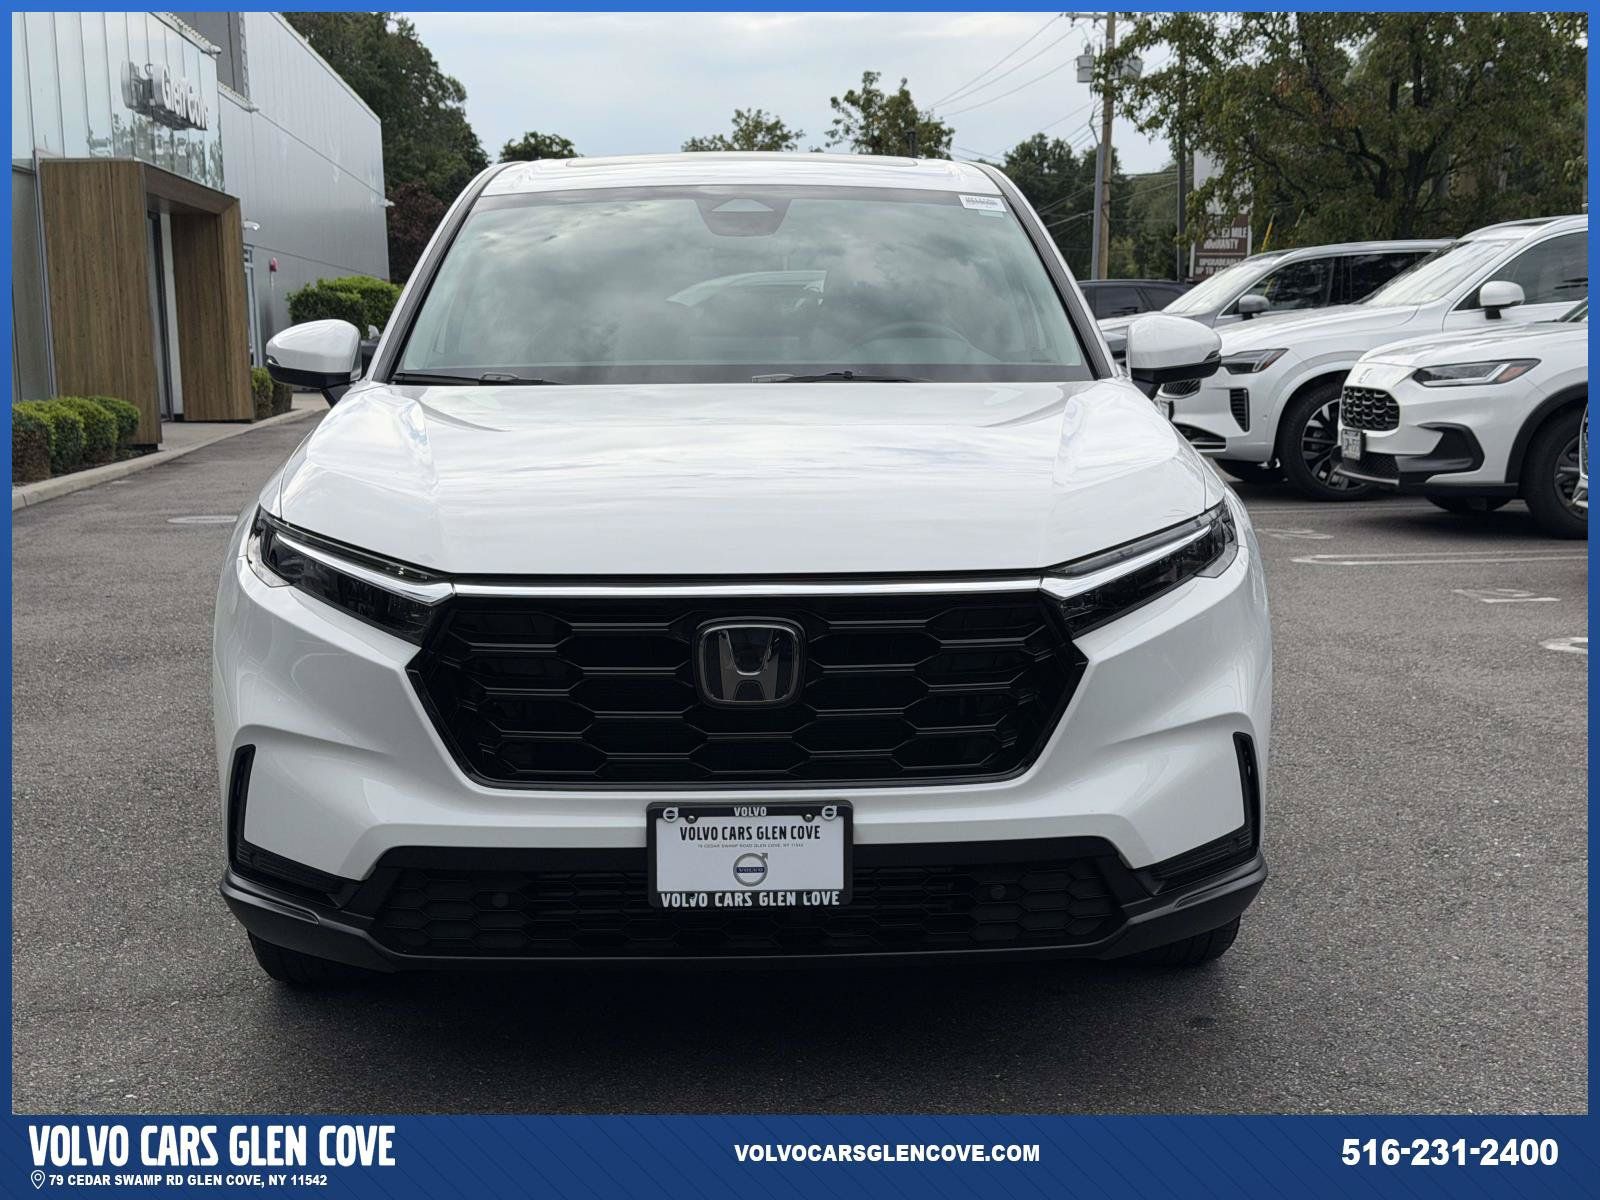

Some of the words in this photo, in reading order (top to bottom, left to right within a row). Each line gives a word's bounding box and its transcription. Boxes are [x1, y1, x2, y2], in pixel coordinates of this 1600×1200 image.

[734, 806, 767, 817] VOLVO
[680, 826, 718, 841] VOLVO
[722, 826, 753, 841] CARS
[757, 825, 787, 840] GLEN
[791, 825, 821, 840] COVE
[714, 892, 753, 908] CARS
[758, 891, 796, 907] GLEN
